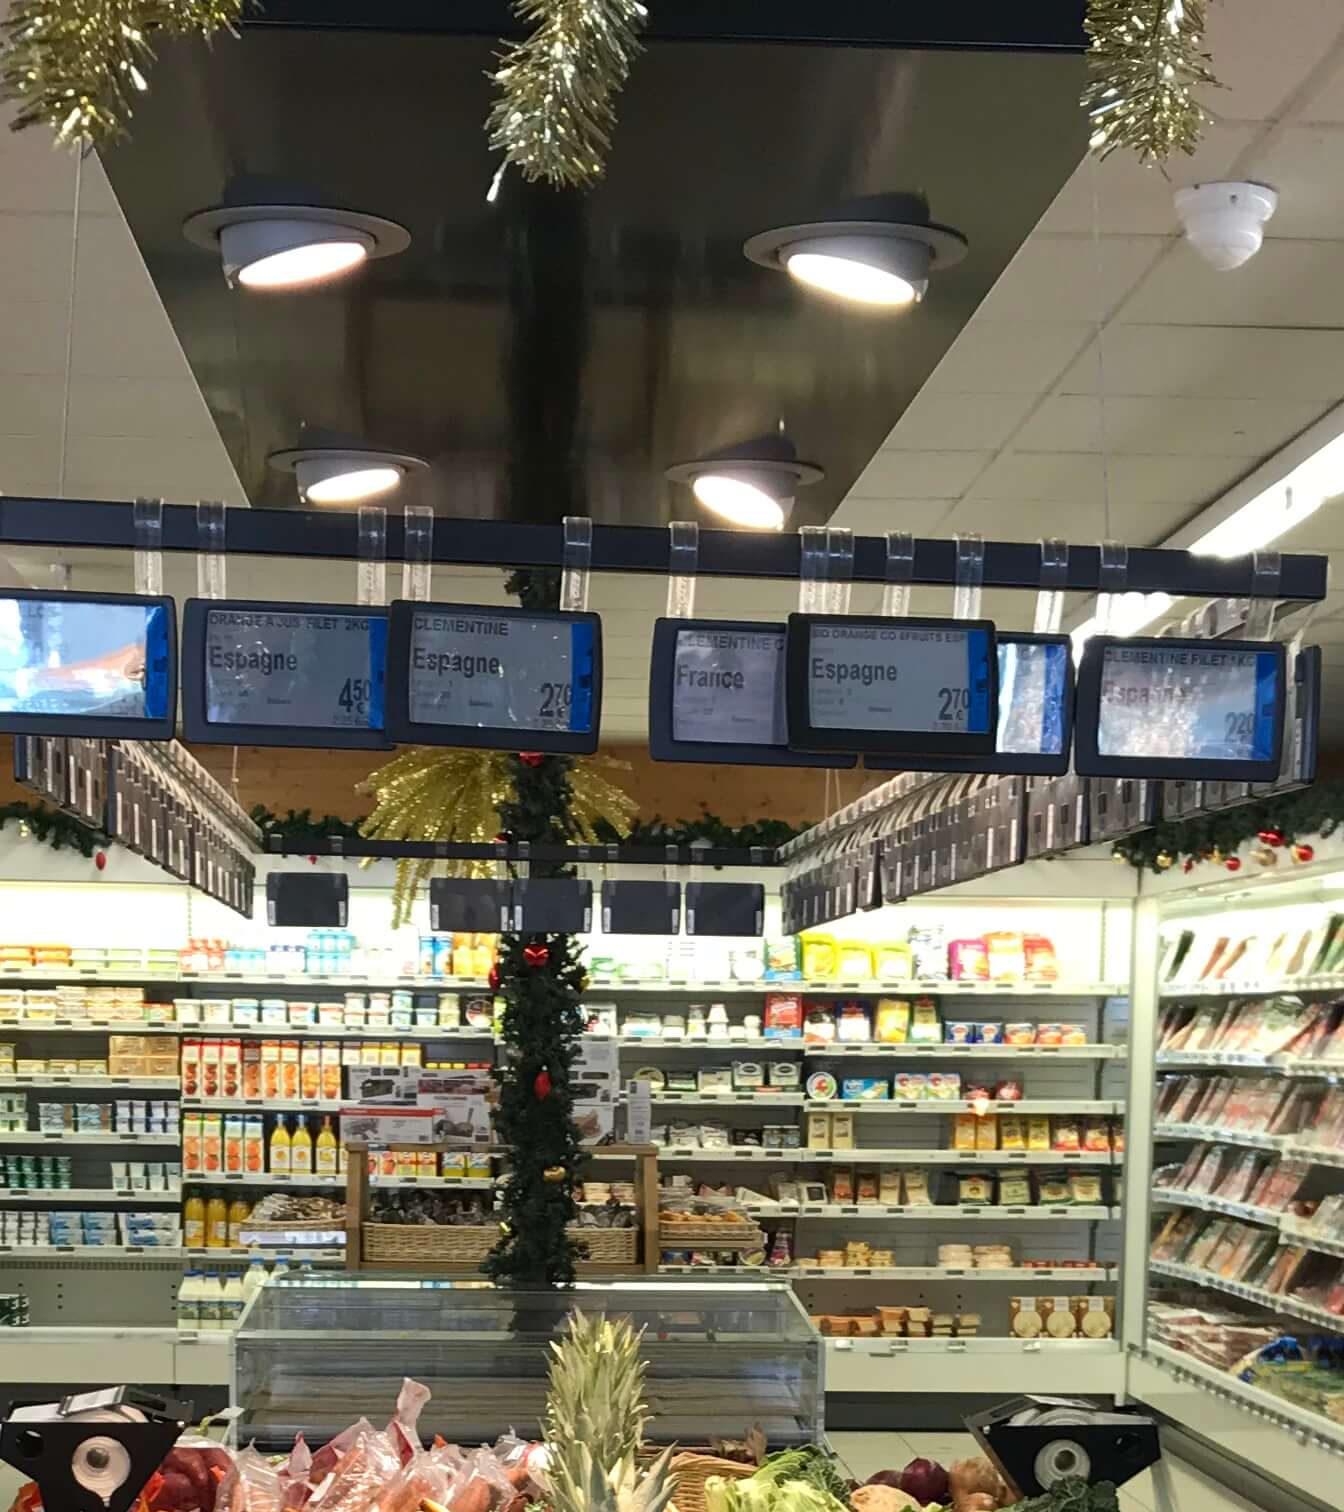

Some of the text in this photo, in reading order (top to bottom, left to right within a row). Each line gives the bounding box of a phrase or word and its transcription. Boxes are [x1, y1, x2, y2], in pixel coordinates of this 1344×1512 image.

[414, 617, 509, 636] CLEMENTINE
[210, 646, 297, 675] Espagne
[413, 648, 502, 677] Espagne
[812, 658, 897, 686] Espagne
[677, 664, 744, 689] France
